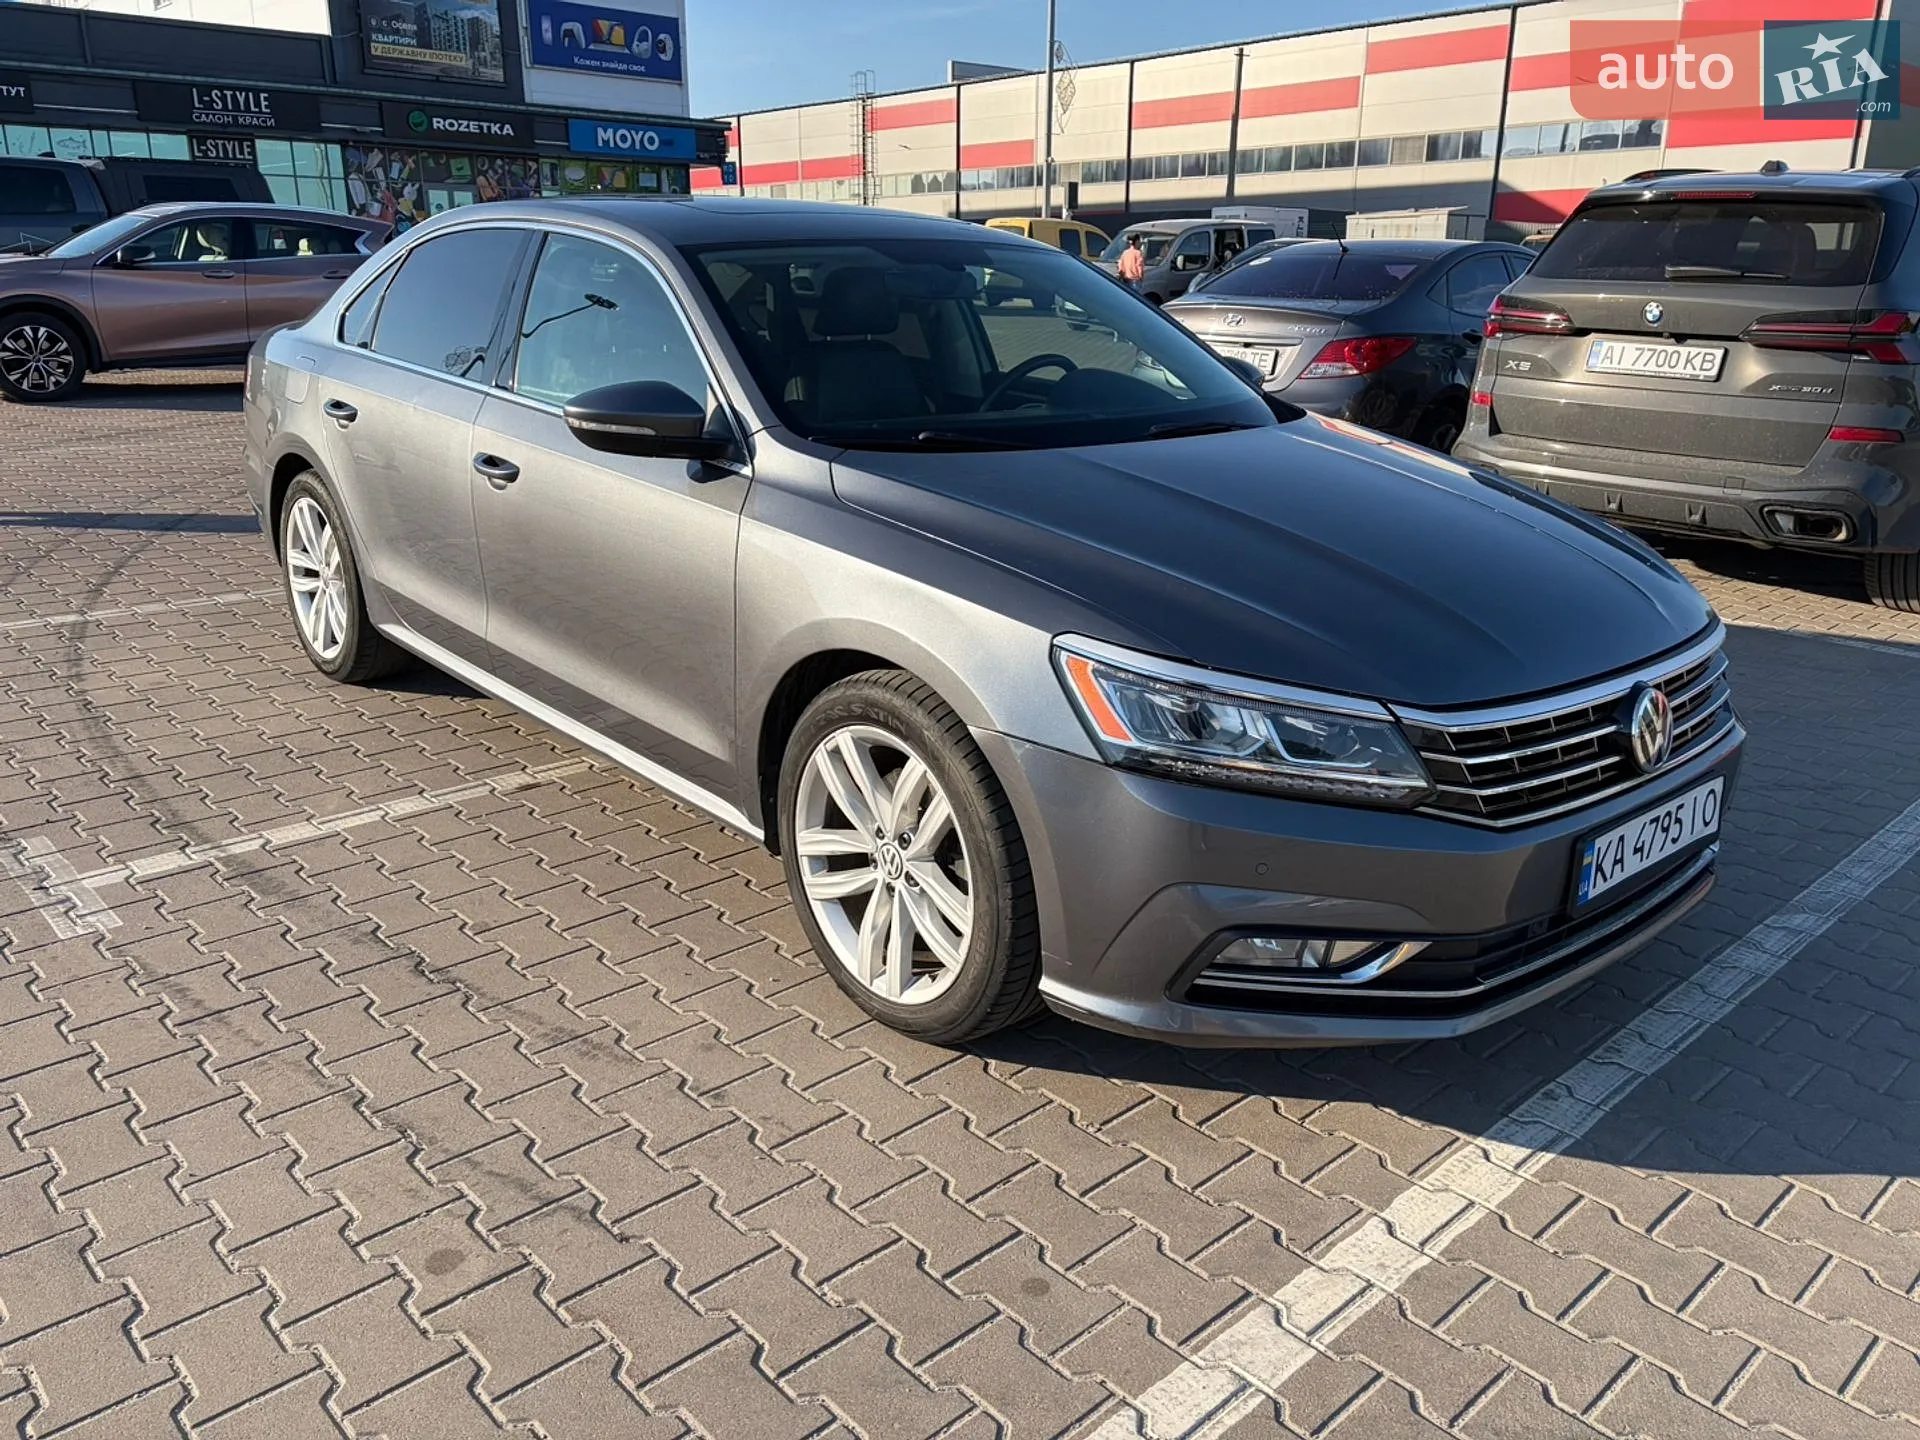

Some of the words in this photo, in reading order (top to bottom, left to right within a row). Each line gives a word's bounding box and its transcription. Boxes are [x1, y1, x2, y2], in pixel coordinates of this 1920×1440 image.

[371, 33, 417, 46] КВАРТИРИ
[381, 46, 427, 58] ДЕРЖАВНУ
[192, 87, 271, 113] L-STYLE
[192, 113, 233, 124] САЛОН
[238, 116, 275, 127] КРАСИ
[432, 117, 515, 136] ROZETKA
[192, 138, 254, 159] L-STYLE
[596, 127, 660, 151] MOYO
[1504, 360, 1532, 371] X5
[1601, 345, 1626, 365] AI
[1631, 346, 1681, 369] 7700
[1683, 350, 1717, 372] KB
[1592, 834, 1625, 889] KA
[1632, 802, 1685, 863] 4795
[1690, 788, 1718, 836] IO
